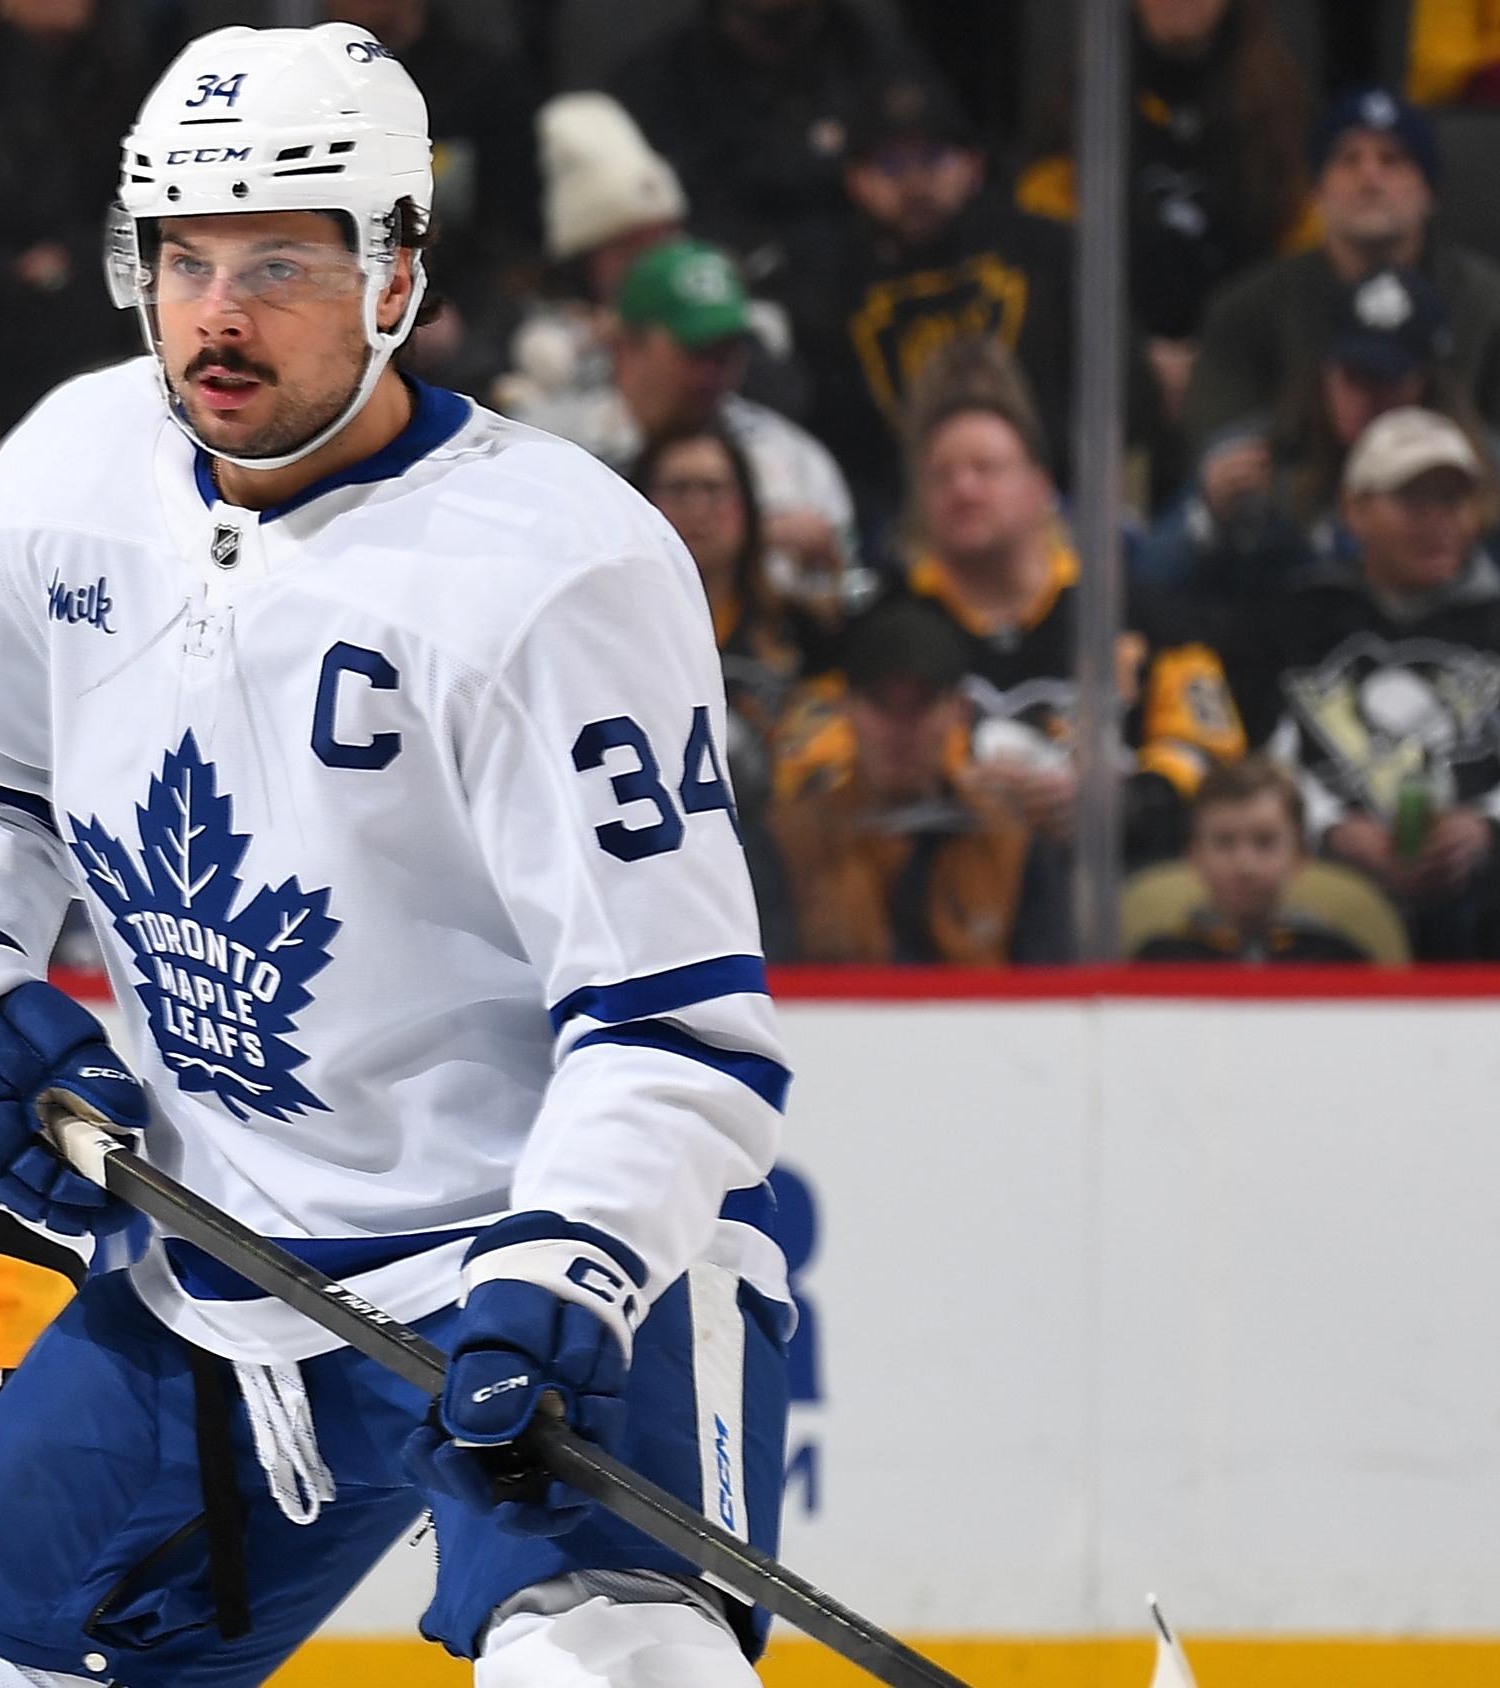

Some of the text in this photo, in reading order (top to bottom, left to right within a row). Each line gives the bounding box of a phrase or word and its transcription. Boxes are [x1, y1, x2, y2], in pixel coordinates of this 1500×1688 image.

[186, 73, 248, 107] 34
[167, 147, 252, 165] CCM
[311, 640, 401, 770] C
[571, 704, 744, 862] 34
[124, 911, 281, 1003] TORONTO
[151, 956, 257, 1028] MAPLE
[161, 997, 266, 1068] LEAFS
[471, 1375, 528, 1404] CCM
[714, 1412, 735, 1533] CCM
